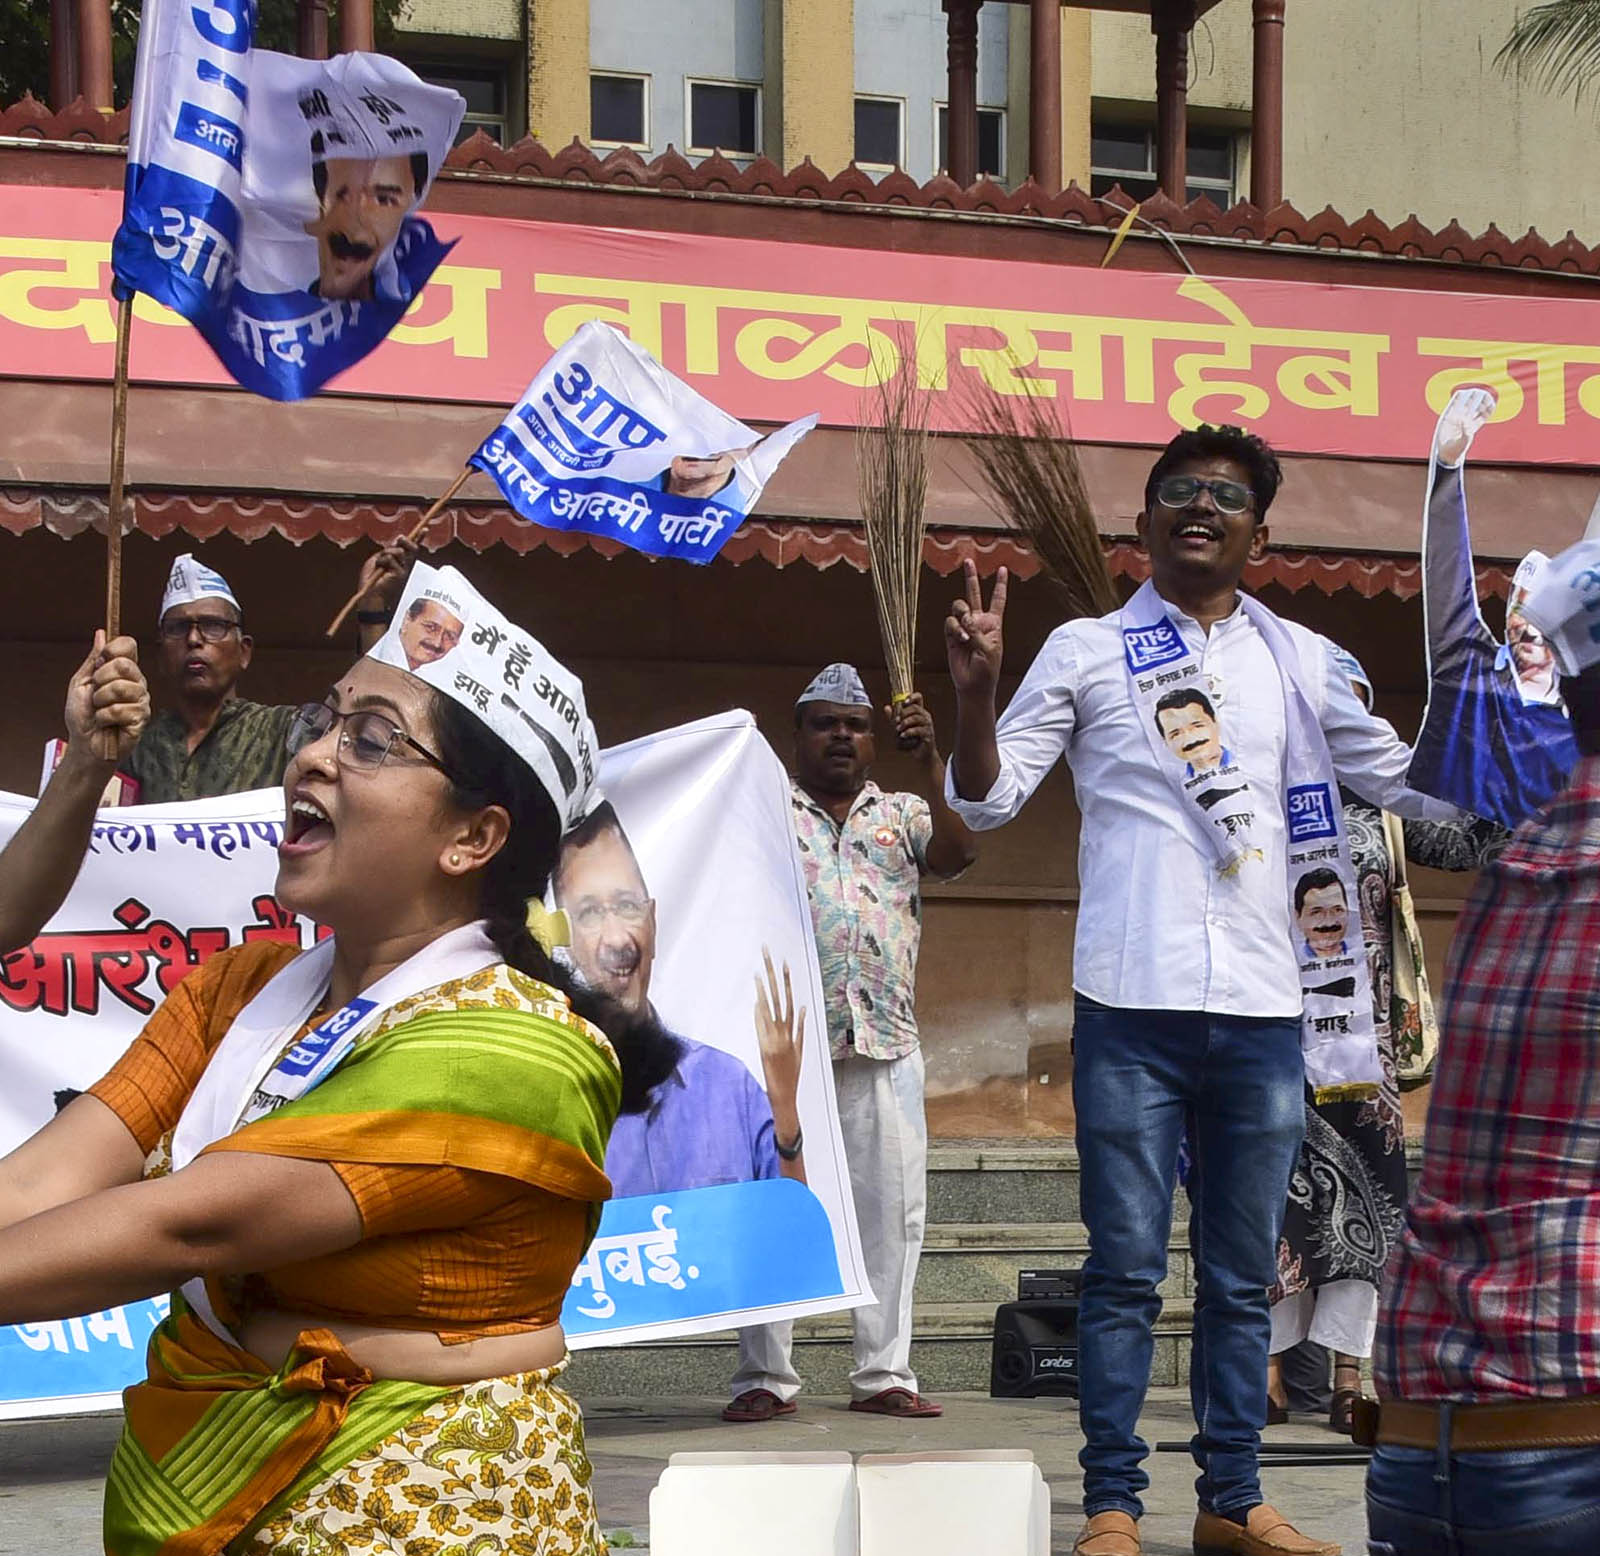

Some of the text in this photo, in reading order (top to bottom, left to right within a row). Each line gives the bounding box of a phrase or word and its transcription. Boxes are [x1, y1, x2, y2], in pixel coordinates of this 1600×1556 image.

[483, 438, 733, 548] आम आदमी पार्टी
[471, 622, 508, 656] मैं
[532, 674, 581, 734] आम
